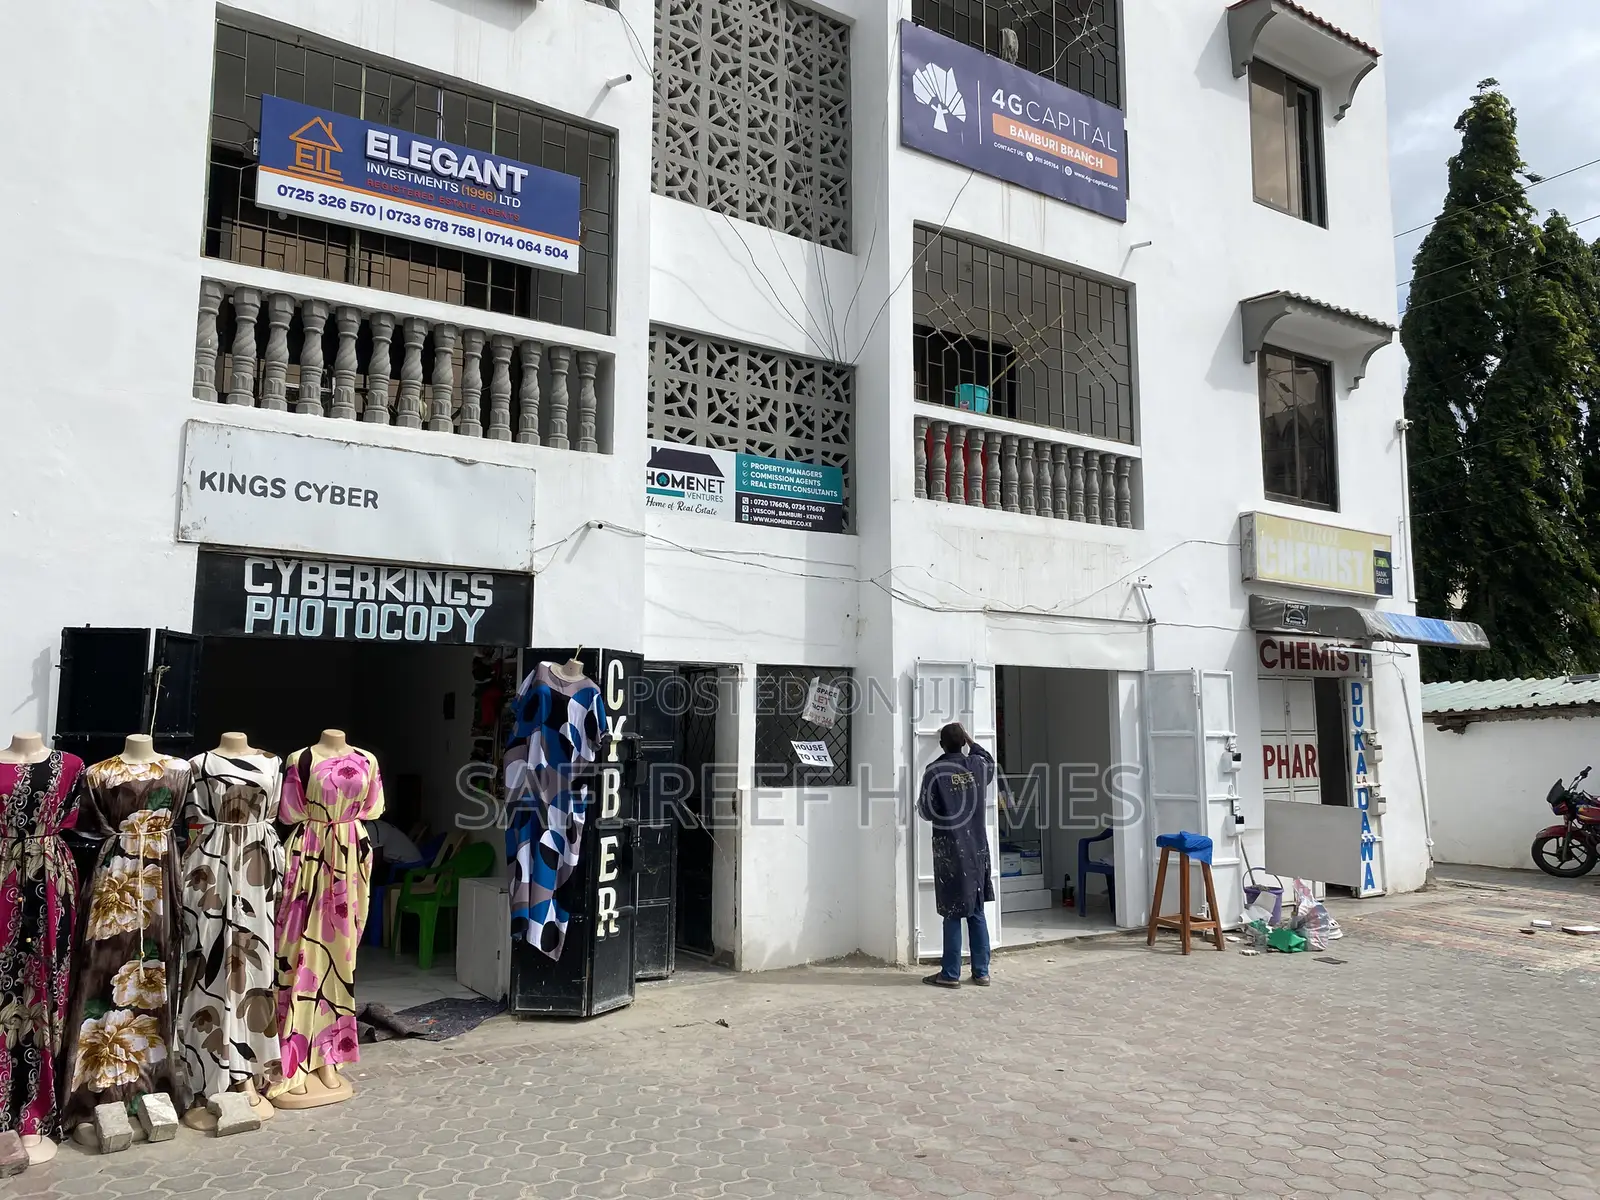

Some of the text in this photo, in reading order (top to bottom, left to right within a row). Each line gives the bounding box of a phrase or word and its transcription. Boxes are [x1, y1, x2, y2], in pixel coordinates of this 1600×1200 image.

[993, 142, 1017, 154] CONTACT
[1009, 125, 1103, 169] BAMBURI BRANCH
[366, 129, 528, 194] ELEGANT
[366, 162, 521, 208] INVESTMENTS (1996) LTD
[367, 179, 520, 221] REGISTERED ESTATE AGENTS
[277, 184, 568, 260] 0725 326 570 0733 678 758 0714 064 504
[646, 471, 725, 494] HOMENET
[750, 462, 822, 478] PROPERTY MANAGERS
[750, 471, 821, 487] COMMISSION AGENTS
[199, 470, 379, 509] KINGS CYBER
[687, 491, 723, 503] VENTURES
[750, 480, 838, 497] REAL ESTATE CONSULTANTS
[753, 498, 769, 506] 0720
[646, 495, 717, 516] Home of Real Estate
[779, 511, 802, 519] BAMBURI
[806, 513, 823, 521] KENYA
[753, 516, 812, 527] WWW.HOMENET.CO.KE
[1259, 534, 1365, 587] CHEMIST
[244, 557, 494, 607] CYBERKINGS
[244, 595, 485, 643] PHOTOCOPY
[1260, 639, 1363, 672] CHEMIST
[816, 687, 838, 699] SPACE
[1351, 682, 1368, 775] DUKA
[794, 743, 824, 752] HOUSE
[799, 753, 811, 761] TO
[1263, 744, 1319, 779] PHAR
[1356, 775, 1367, 784] LA
[596, 659, 627, 937] CYBER
[1358, 787, 1375, 891] DAWA
